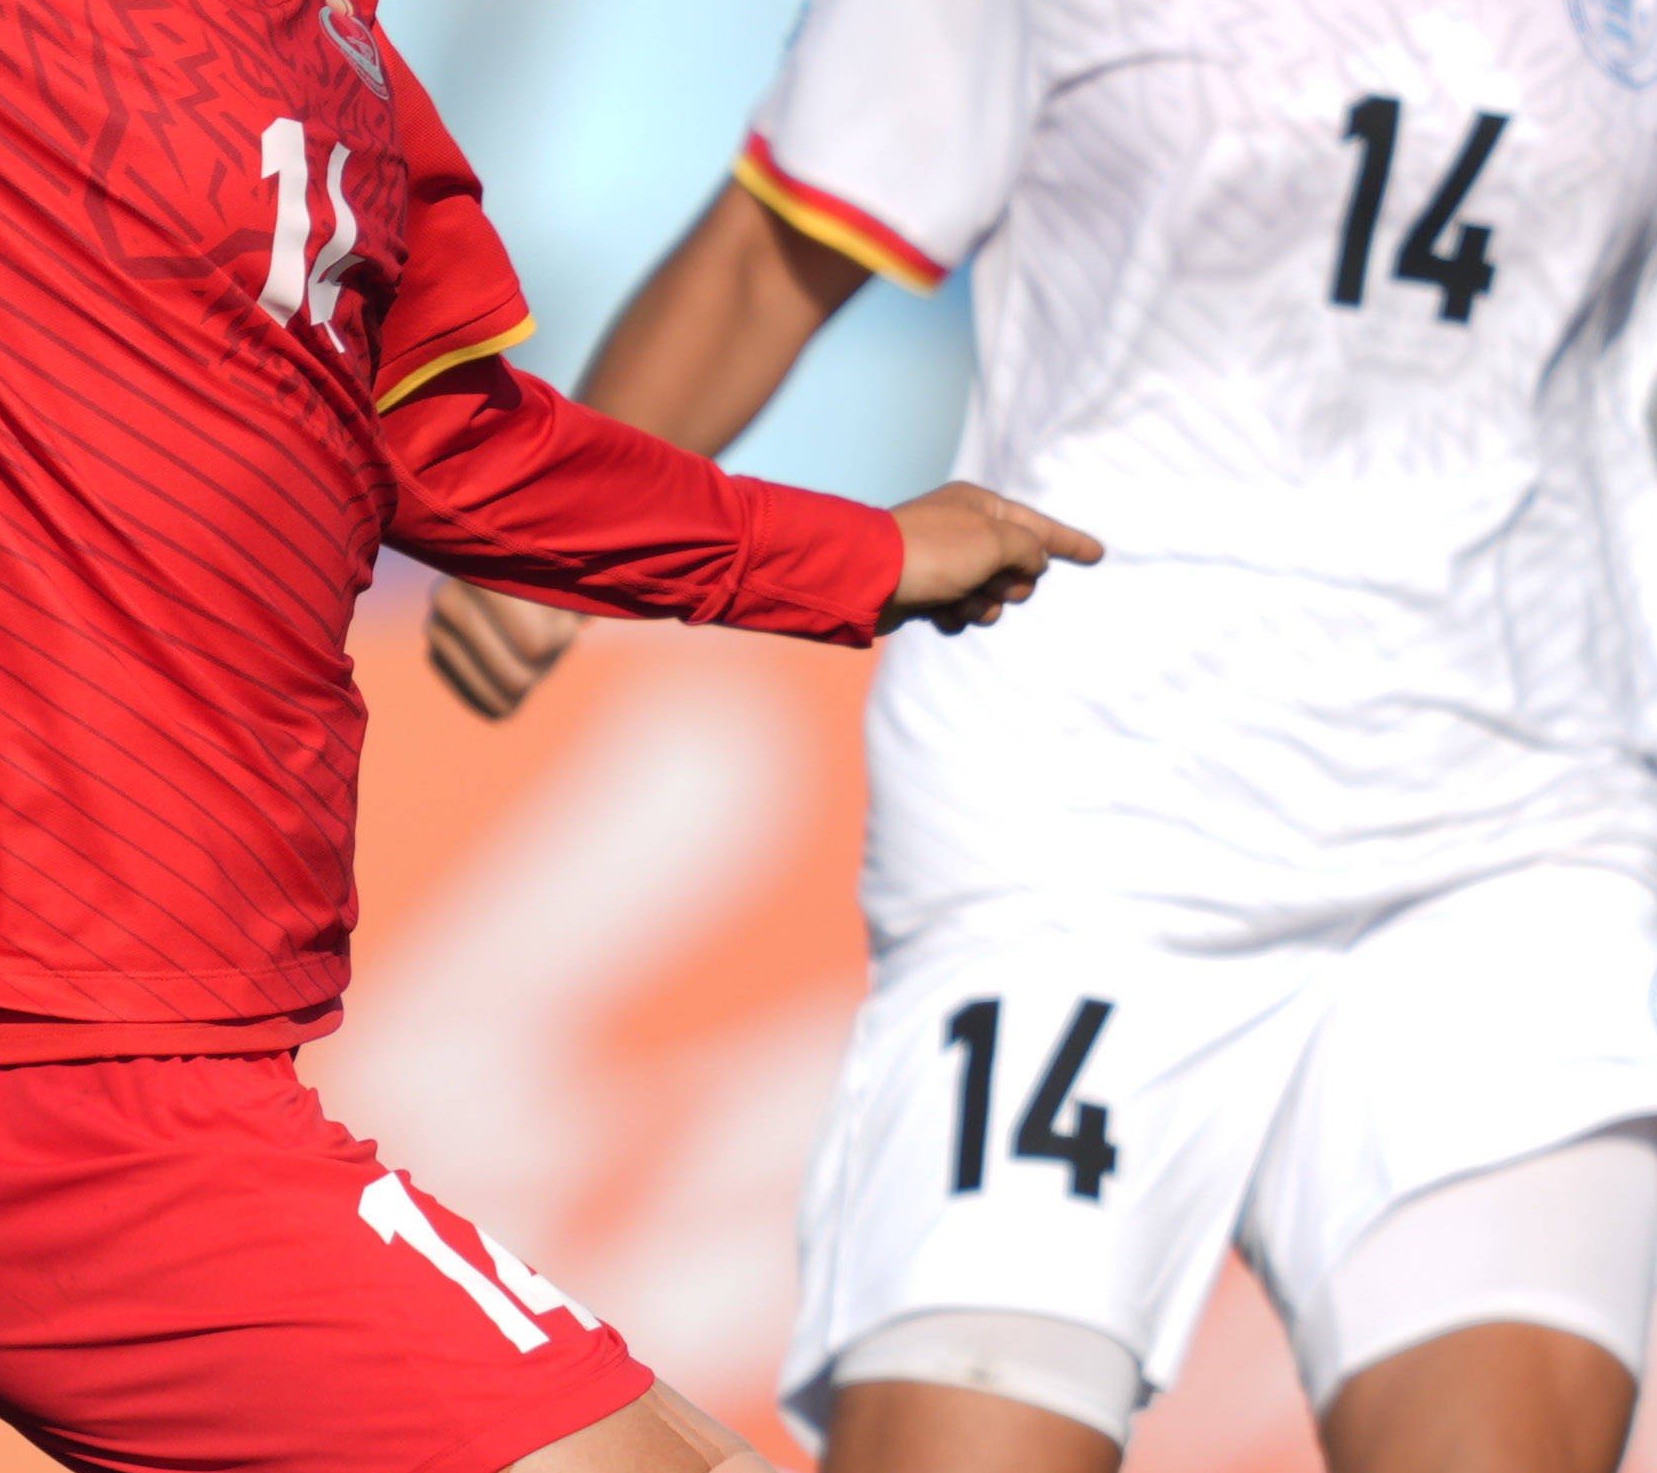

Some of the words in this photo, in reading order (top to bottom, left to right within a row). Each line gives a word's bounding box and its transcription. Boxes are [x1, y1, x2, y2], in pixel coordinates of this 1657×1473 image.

[1327, 93, 1514, 324] 14
[942, 995, 1118, 1202] 14
[357, 1171, 602, 1354] 14
